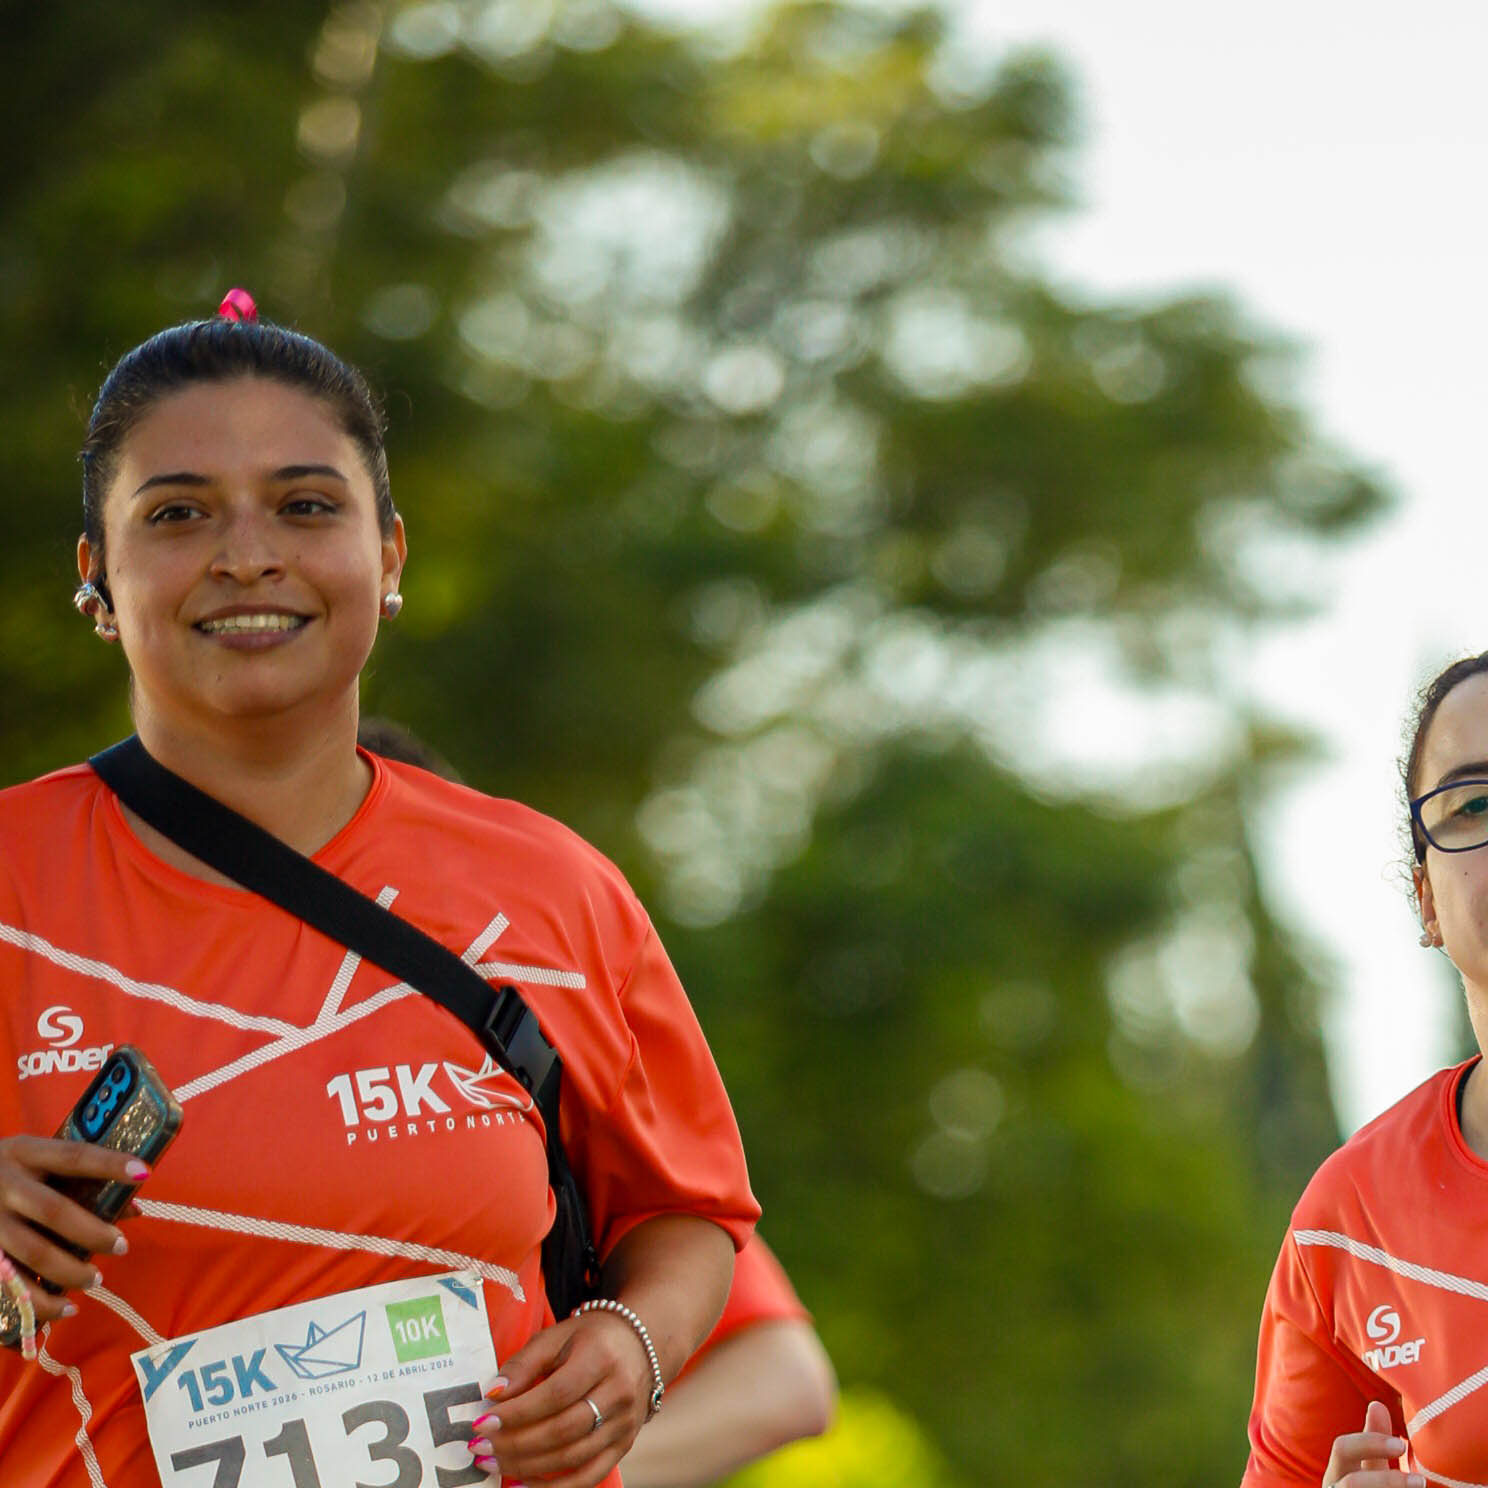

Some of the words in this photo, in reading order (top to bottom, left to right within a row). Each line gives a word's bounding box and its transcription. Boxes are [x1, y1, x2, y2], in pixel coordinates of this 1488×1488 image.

[326, 1063, 451, 1126] 15K
[347, 1117, 455, 1145] PUERTO
[395, 1313, 441, 1344] 10K
[177, 1347, 278, 1413] 15K
[188, 1411, 230, 1429] PUERTO
[233, 1400, 268, 1416] NORTE
[272, 1393, 298, 1407] 2026
[309, 1379, 356, 1396] ROSARIO
[367, 1373, 378, 1384] 12
[383, 1370, 395, 1380] DE
[399, 1362, 428, 1377] ABRIL
[431, 1358, 454, 1371] 2026
